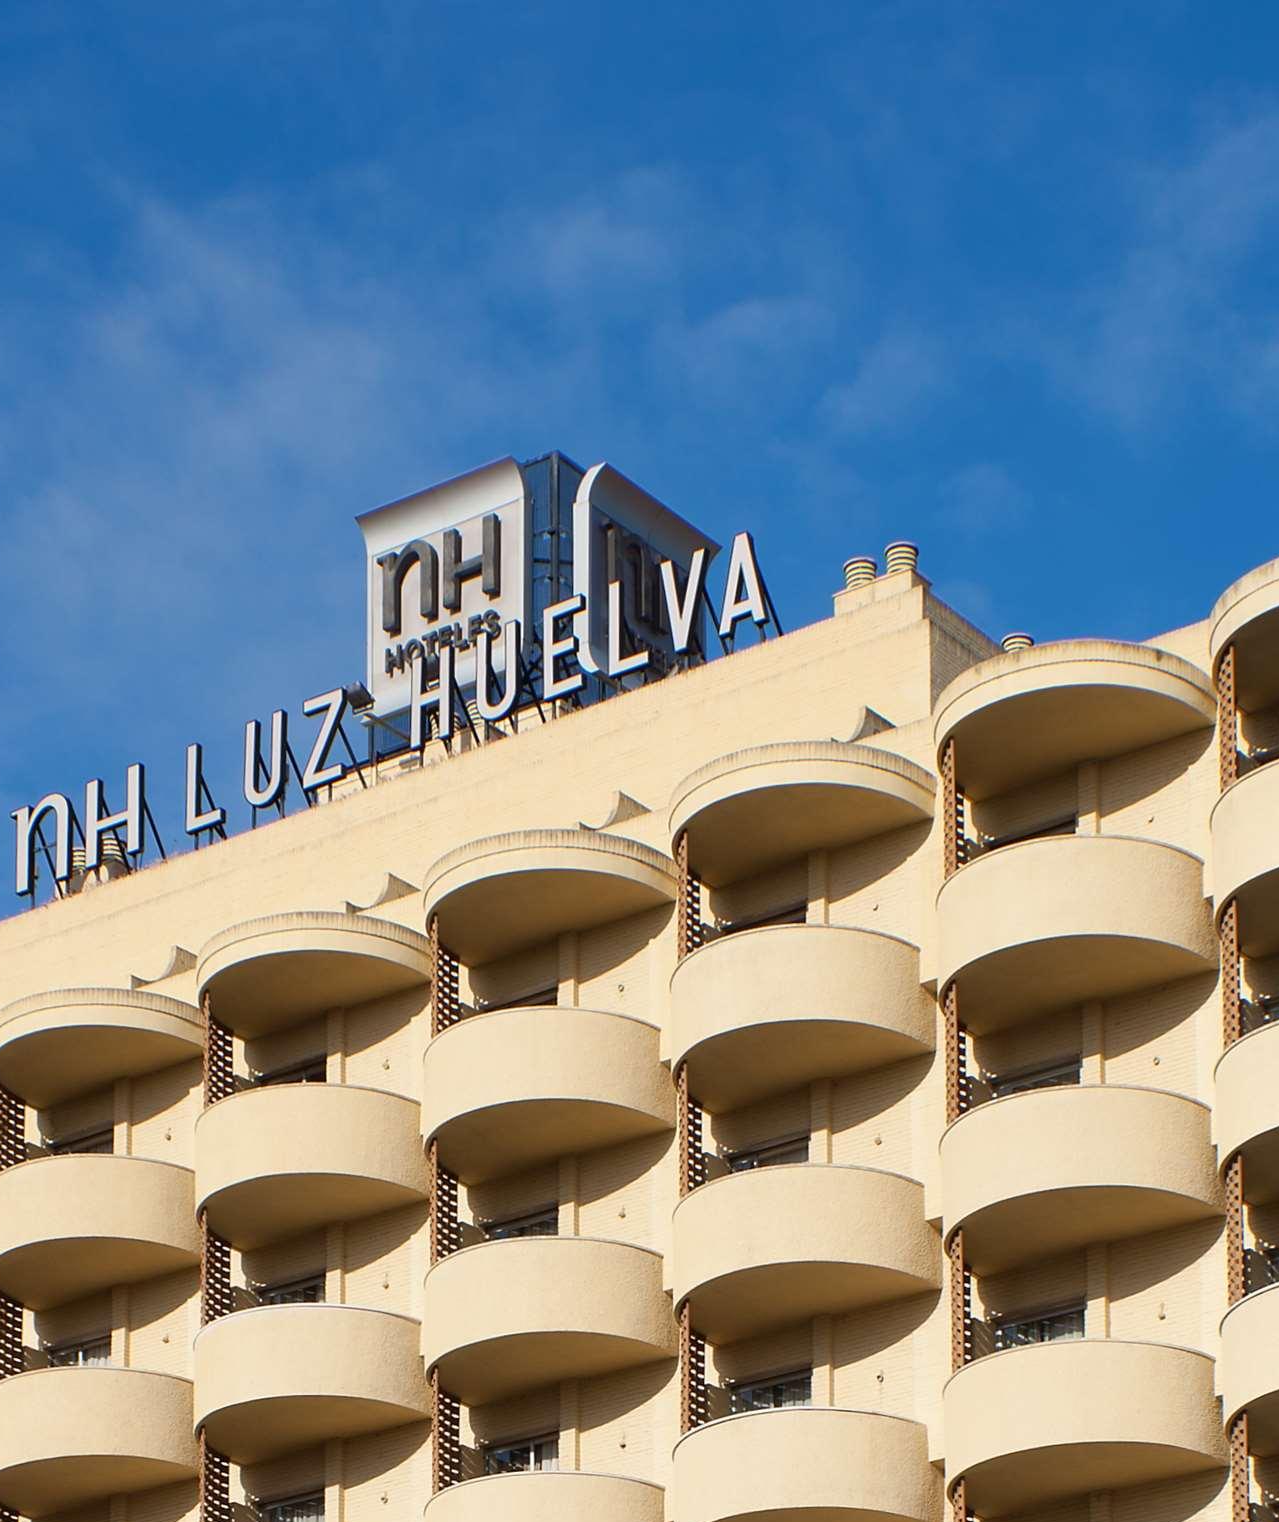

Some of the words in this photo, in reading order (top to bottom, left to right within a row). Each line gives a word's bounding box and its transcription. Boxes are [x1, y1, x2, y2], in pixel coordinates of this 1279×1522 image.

[185, 686, 348, 837] LUZ
[410, 530, 769, 751] HUELVA
[385, 608, 502, 678] HOTELES
